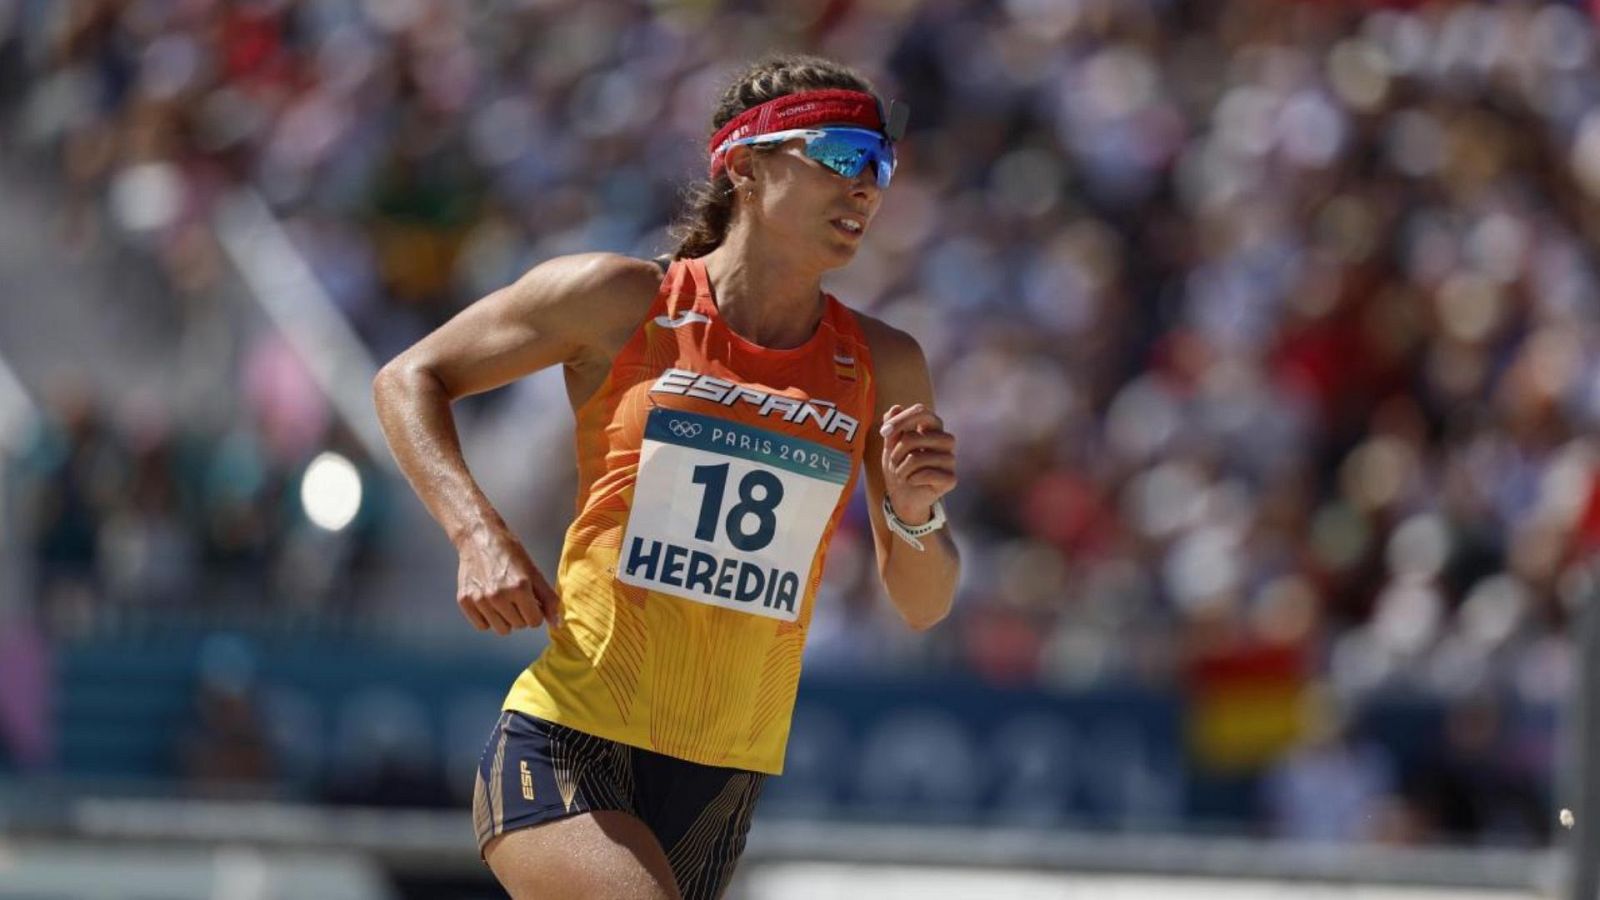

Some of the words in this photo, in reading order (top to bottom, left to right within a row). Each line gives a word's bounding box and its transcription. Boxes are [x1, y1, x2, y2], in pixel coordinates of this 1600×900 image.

[649, 368, 859, 443] ESPAÑA
[779, 444, 831, 473] 2024
[692, 462, 784, 552] 18
[626, 536, 800, 613] HEREDIA
[520, 760, 534, 800] ESP
